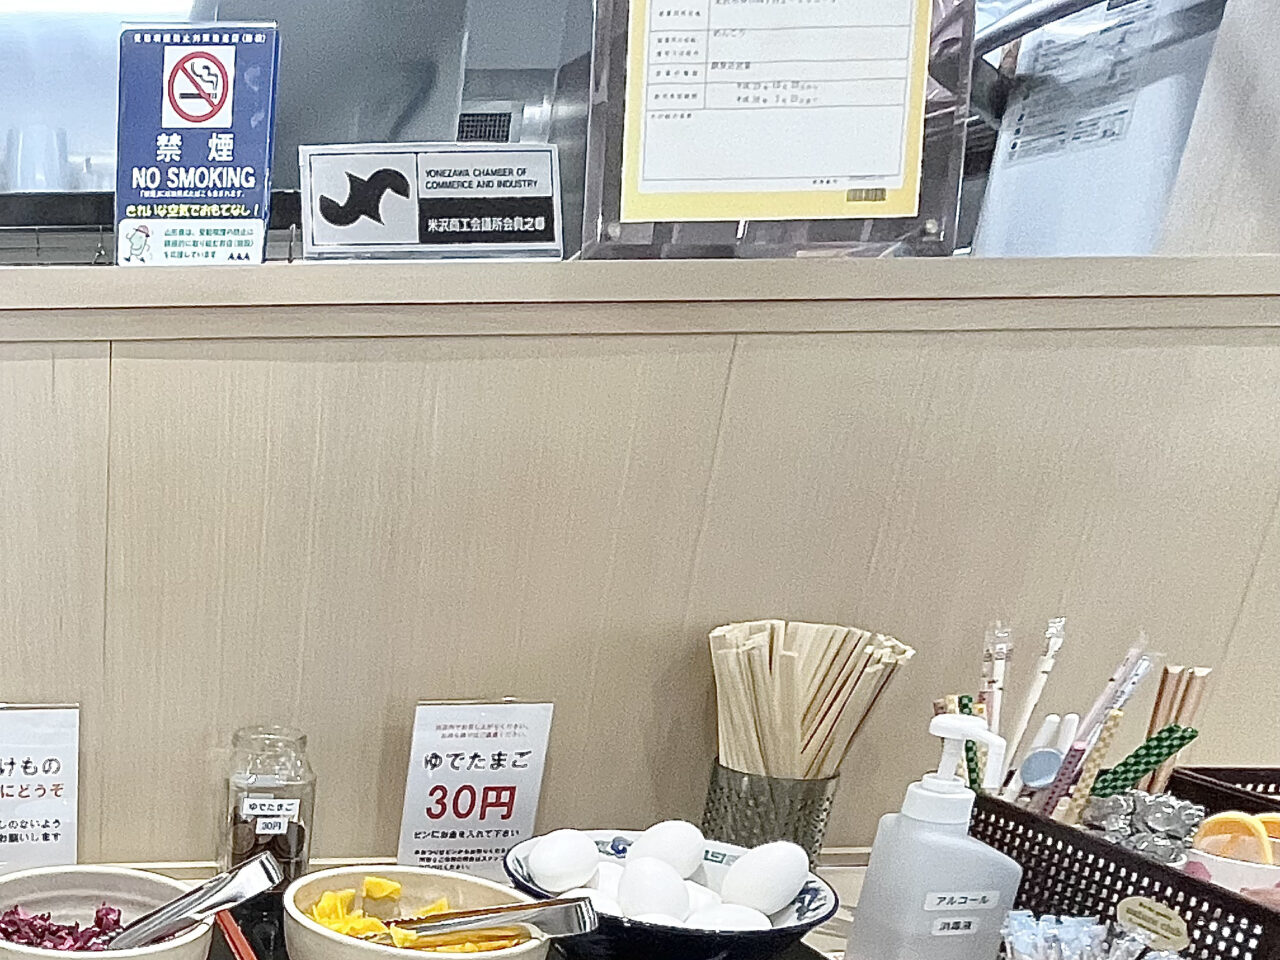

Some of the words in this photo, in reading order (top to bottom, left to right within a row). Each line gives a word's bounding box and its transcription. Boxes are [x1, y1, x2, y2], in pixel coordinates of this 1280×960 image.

[156, 133, 183, 162] 禁
[207, 133, 234, 162] 煙
[132, 167, 161, 189] NO
[166, 167, 256, 189] SMOKING
[425, 169, 470, 178] YONEZAWA
[472, 168, 514, 177] CHAMBER
[516, 168, 527, 176] OF
[425, 181, 473, 190] COMMERCE
[476, 180, 494, 189] AND
[497, 180, 538, 189] INDUSTRY
[424, 751, 532, 770] ゆでたまご
[248, 802, 295, 811] ゆでたまご
[426, 784, 517, 820] 30円
[261, 822, 282, 830] 30円
[936, 896, 990, 905] アルコール
